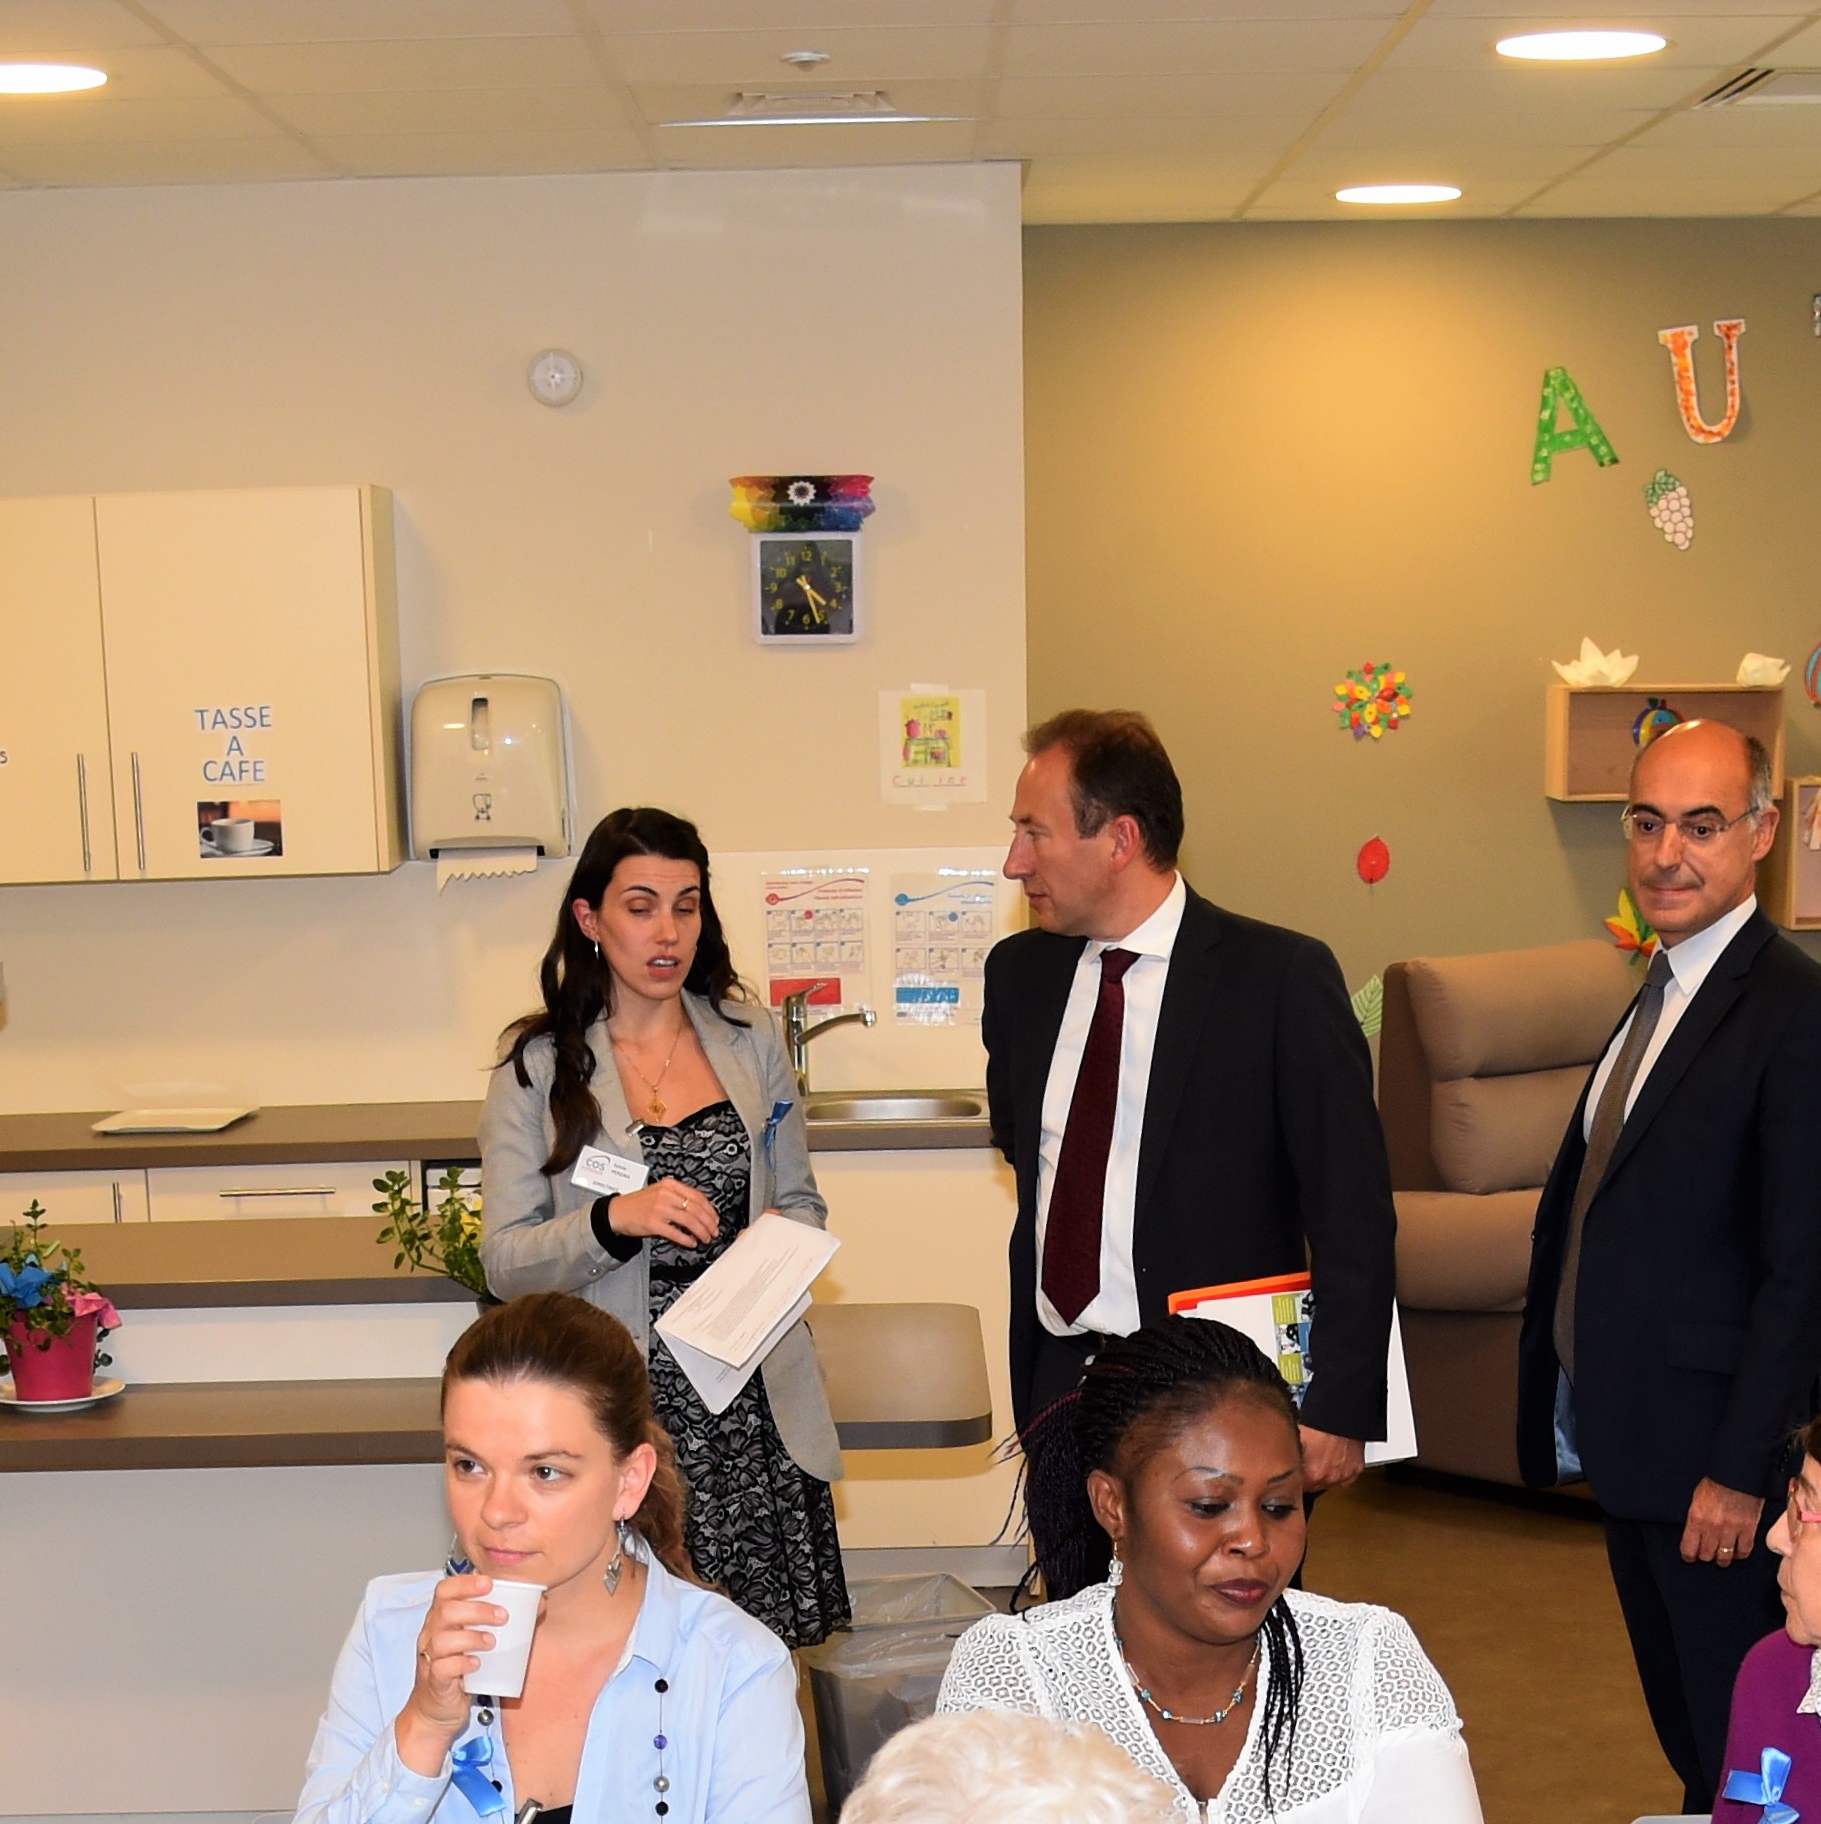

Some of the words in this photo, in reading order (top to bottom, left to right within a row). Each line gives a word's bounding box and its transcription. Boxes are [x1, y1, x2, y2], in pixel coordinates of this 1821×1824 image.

[194, 706, 272, 731] TASSE
[226, 735, 244, 757] A
[202, 760, 265, 782] CAFE
[586, 1158, 606, 1171] COS
